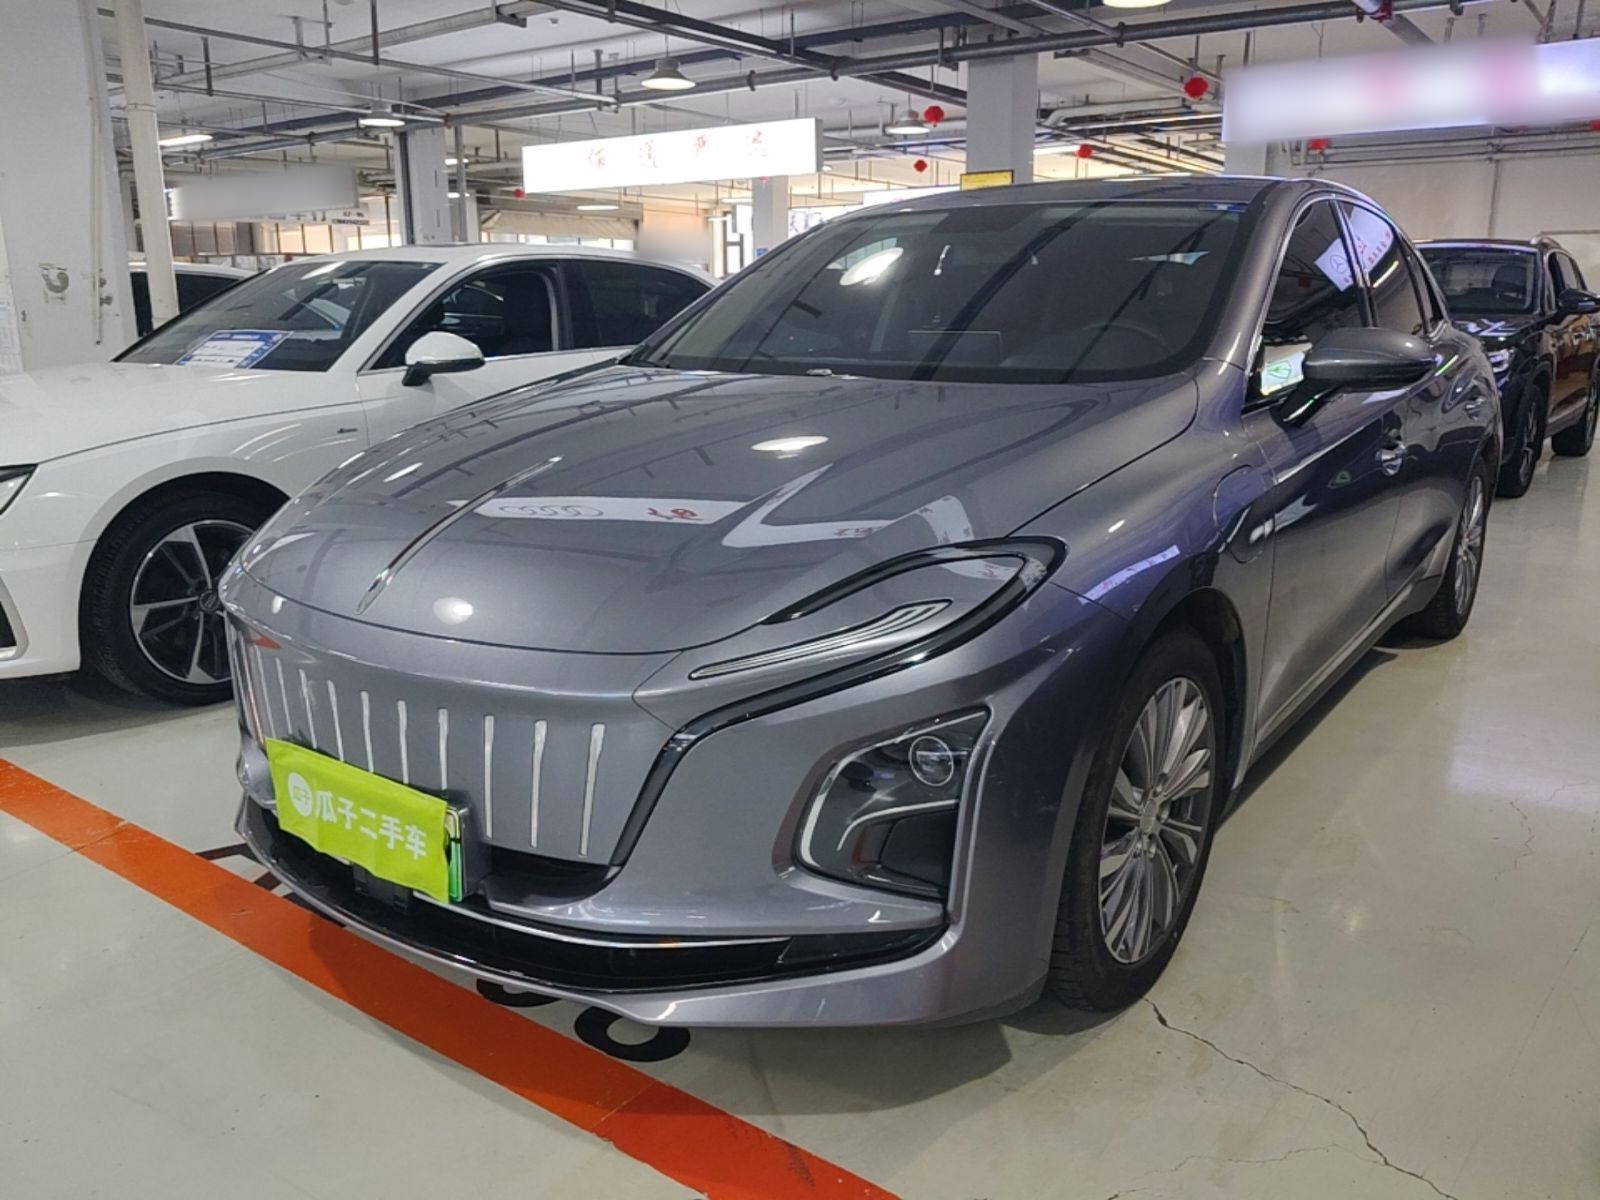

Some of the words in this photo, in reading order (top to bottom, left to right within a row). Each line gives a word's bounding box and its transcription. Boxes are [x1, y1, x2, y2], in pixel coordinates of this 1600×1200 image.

[315, 790, 427, 860] 瓜子二手车
